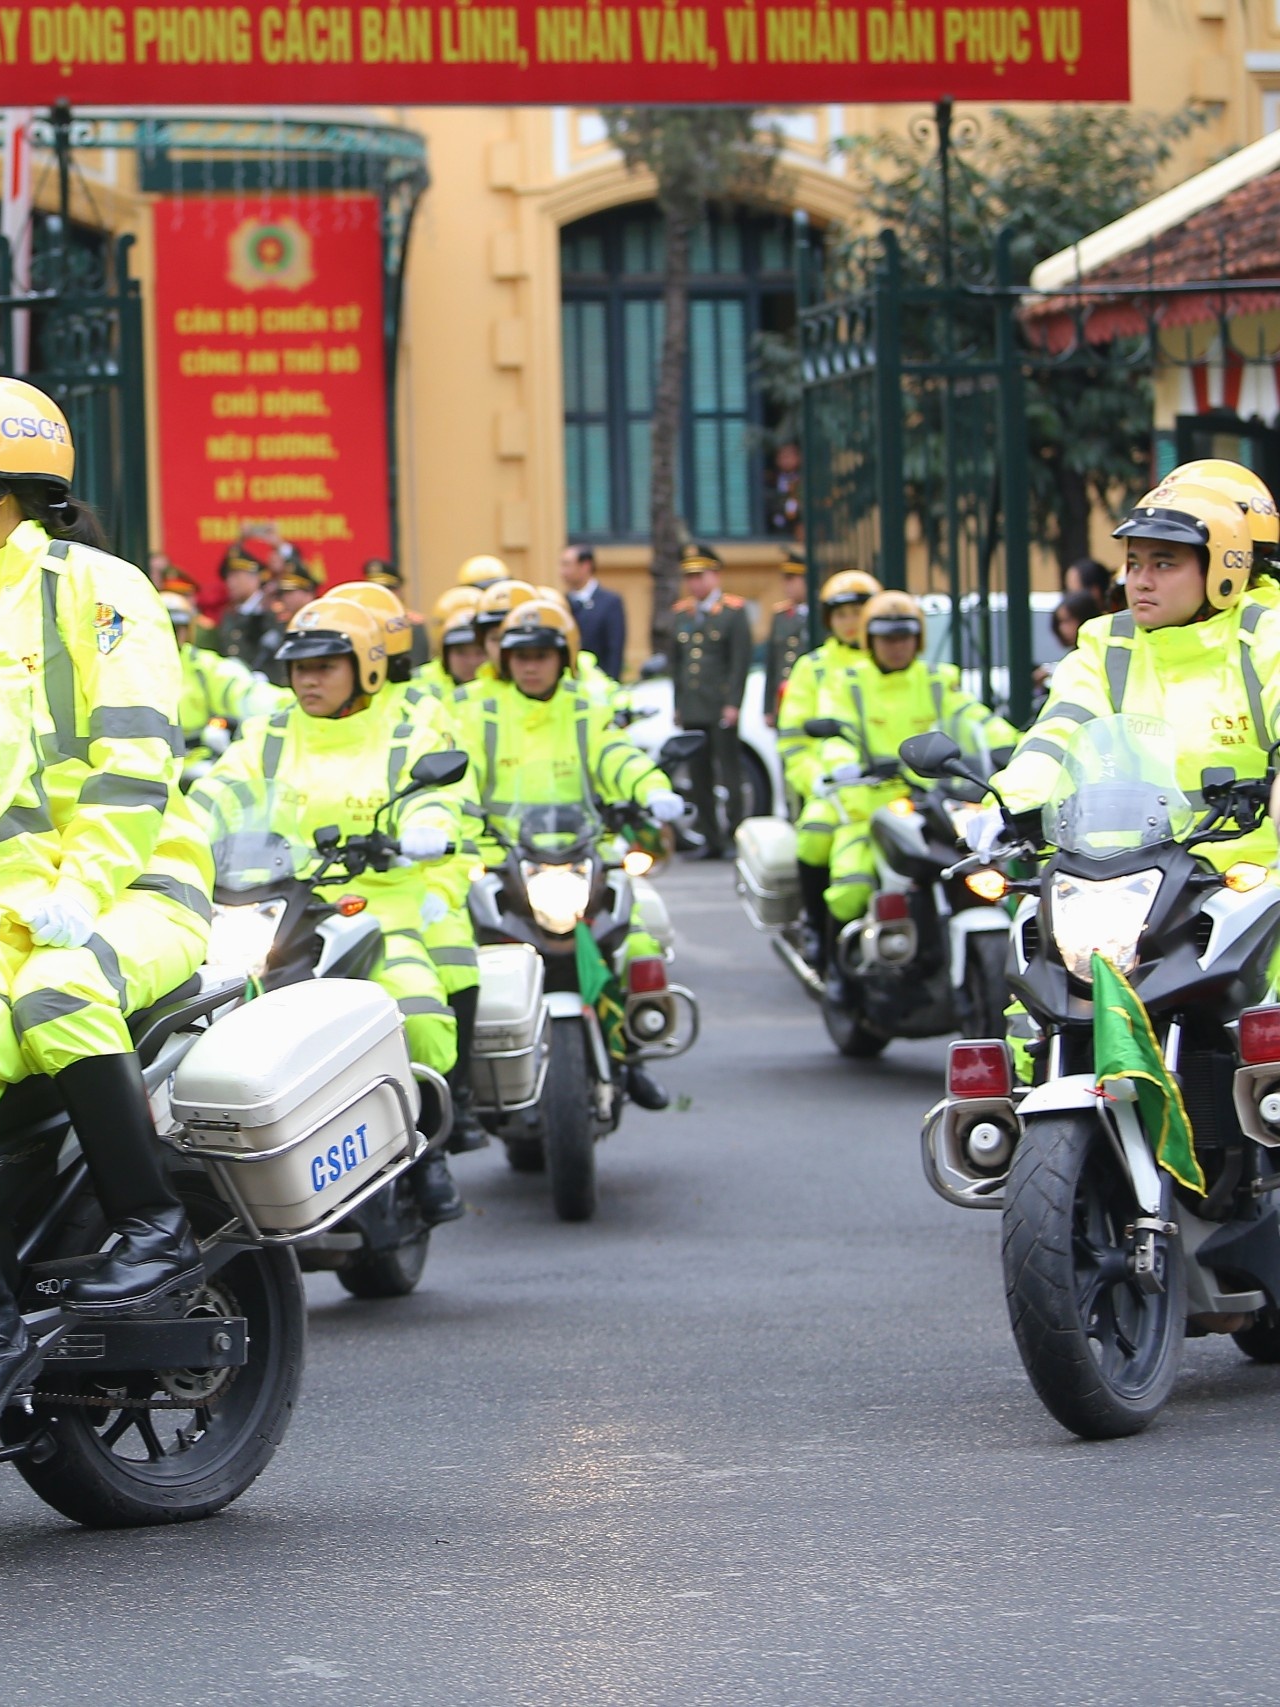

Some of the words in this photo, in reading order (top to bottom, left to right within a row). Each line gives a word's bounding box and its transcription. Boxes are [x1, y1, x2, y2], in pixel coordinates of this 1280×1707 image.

[30, 3, 126, 77] DỰNG
[134, 6, 252, 65] PHONG
[260, 0, 352, 65] CÁCH
[536, 0, 631, 65] NHÂN
[724, 0, 758, 65] VÌ
[765, 0, 859, 65] NHÂN
[866, 0, 937, 65] DÂN
[943, 6, 1032, 76] PHỤC
[1038, 6, 1082, 76] VỤ
[0, 417, 67, 443] CSGT
[1251, 496, 1278, 518] CS
[310, 1123, 369, 1192] CSGT
